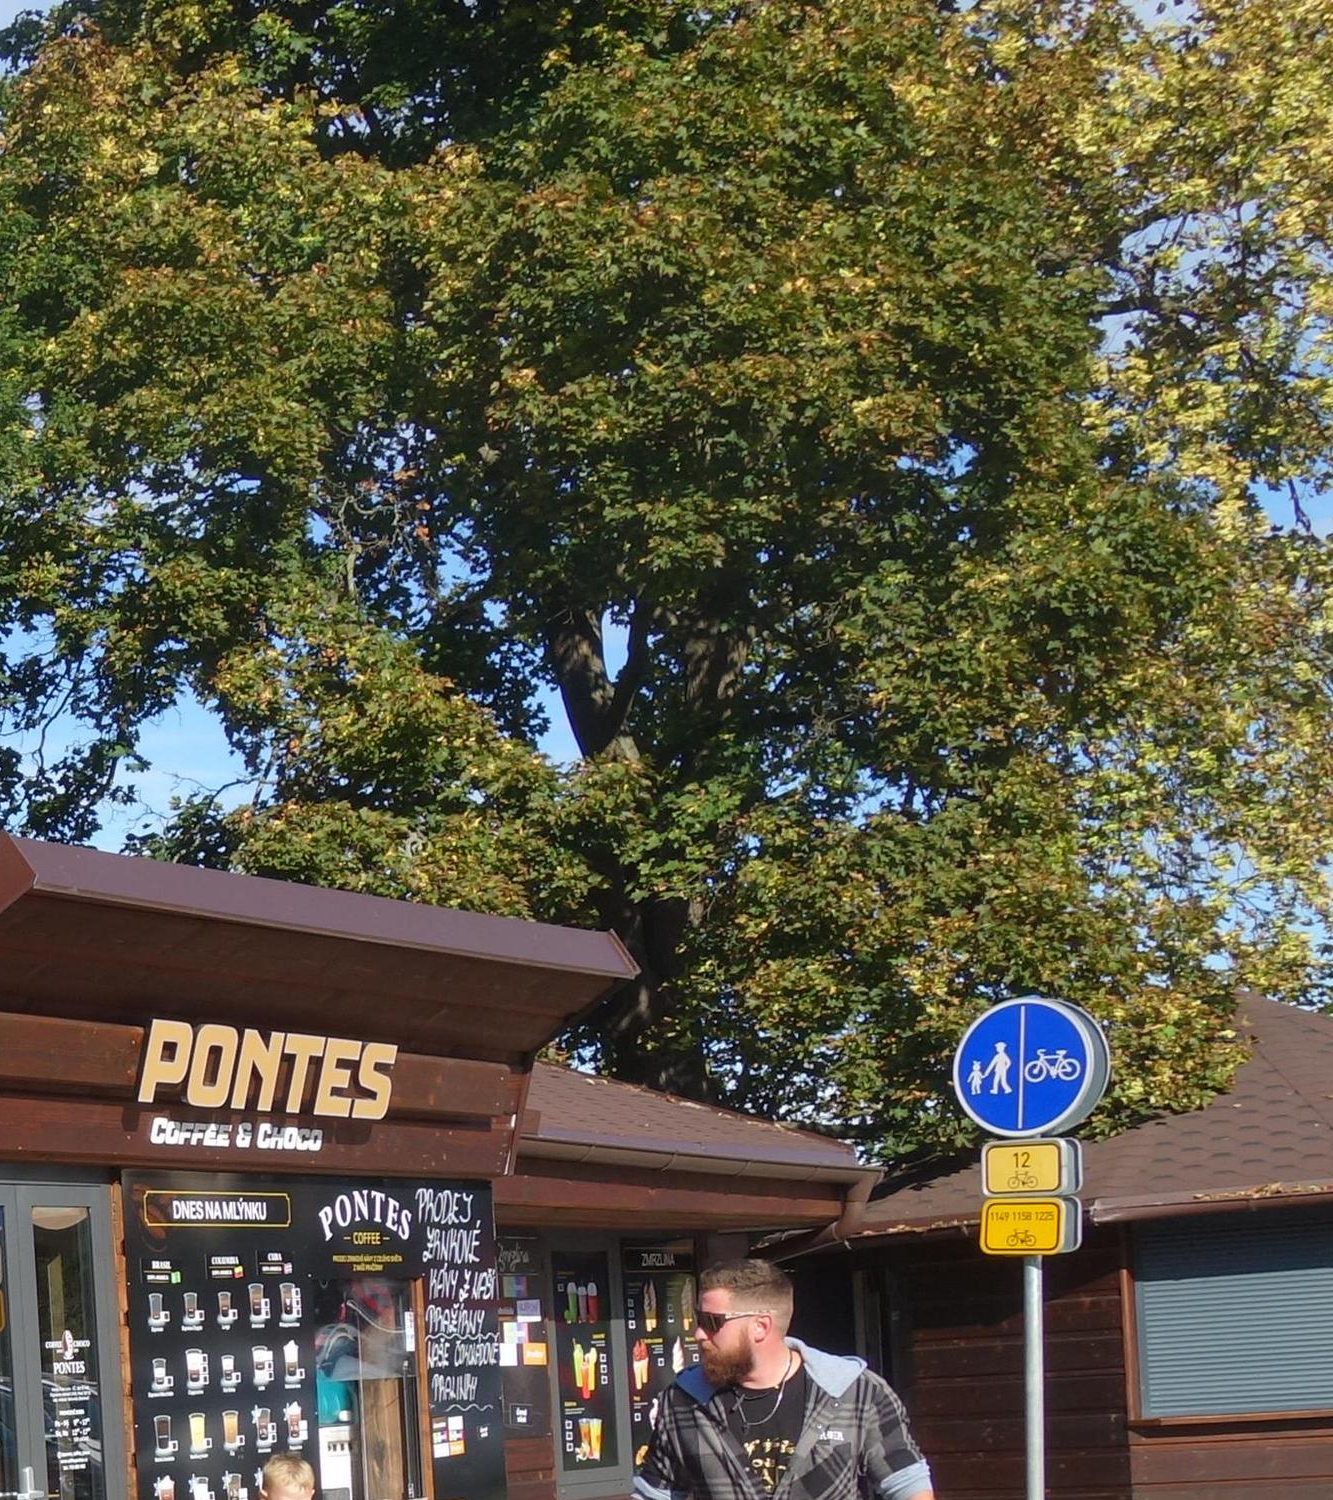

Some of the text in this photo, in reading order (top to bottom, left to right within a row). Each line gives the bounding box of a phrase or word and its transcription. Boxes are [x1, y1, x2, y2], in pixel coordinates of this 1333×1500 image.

[138, 1019, 399, 1121] PONTES
[150, 1117, 323, 1152] COFFEE & CHOCO
[1013, 1151, 1031, 1169] 12
[172, 1197, 267, 1221] DNES NA MLÝNKU
[318, 1189, 413, 1242] PONTES
[414, 1187, 474, 1225] PRODEJ
[352, 1231, 382, 1245] COFFEE
[422, 1219, 482, 1264] ZRNKOVÉ
[53, 1360, 86, 1375] PONTES
